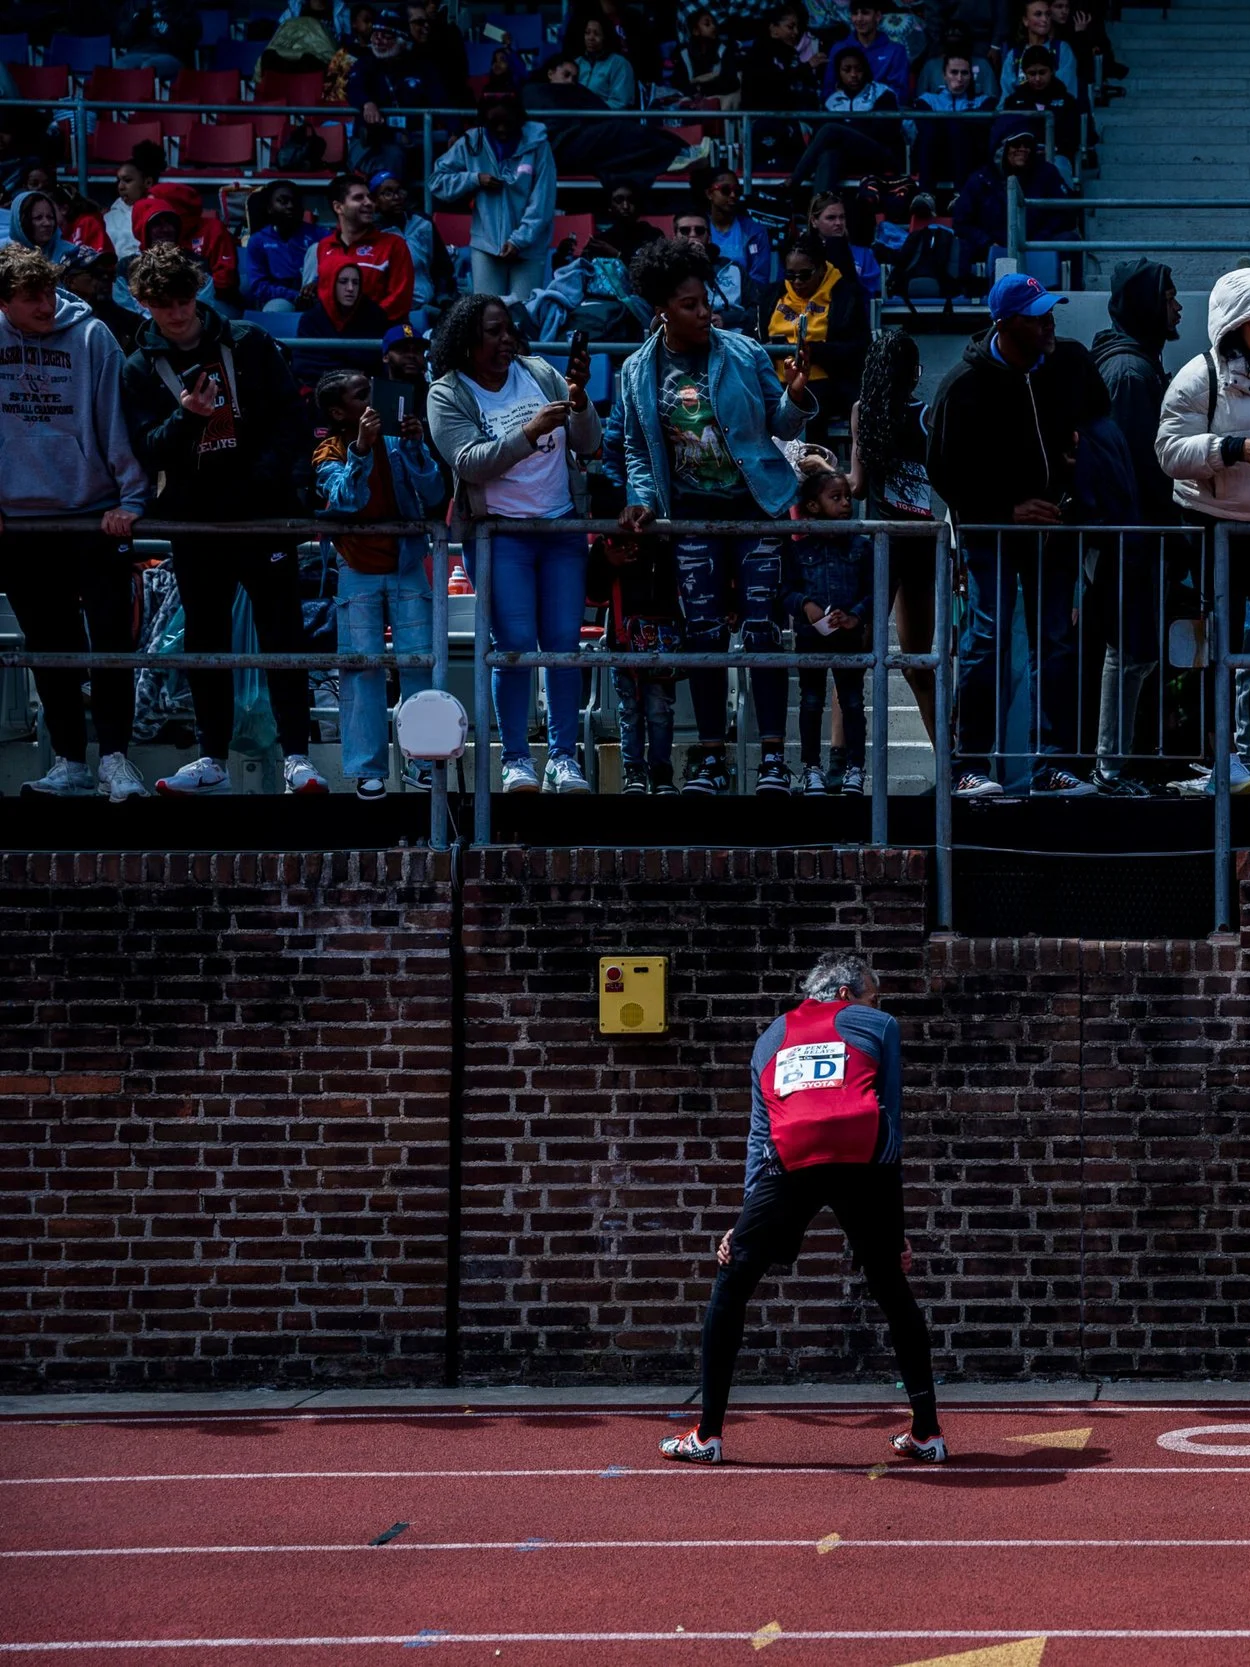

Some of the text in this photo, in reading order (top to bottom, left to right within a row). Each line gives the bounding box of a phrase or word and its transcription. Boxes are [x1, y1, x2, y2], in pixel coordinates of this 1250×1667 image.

[9, 392, 61, 402] STATE
[2, 403, 74, 415] FOOTBALL CHAMPIONS
[899, 502, 927, 516] TOYOTA
[606, 983, 622, 991] HELP
[814, 1061, 837, 1079] D
